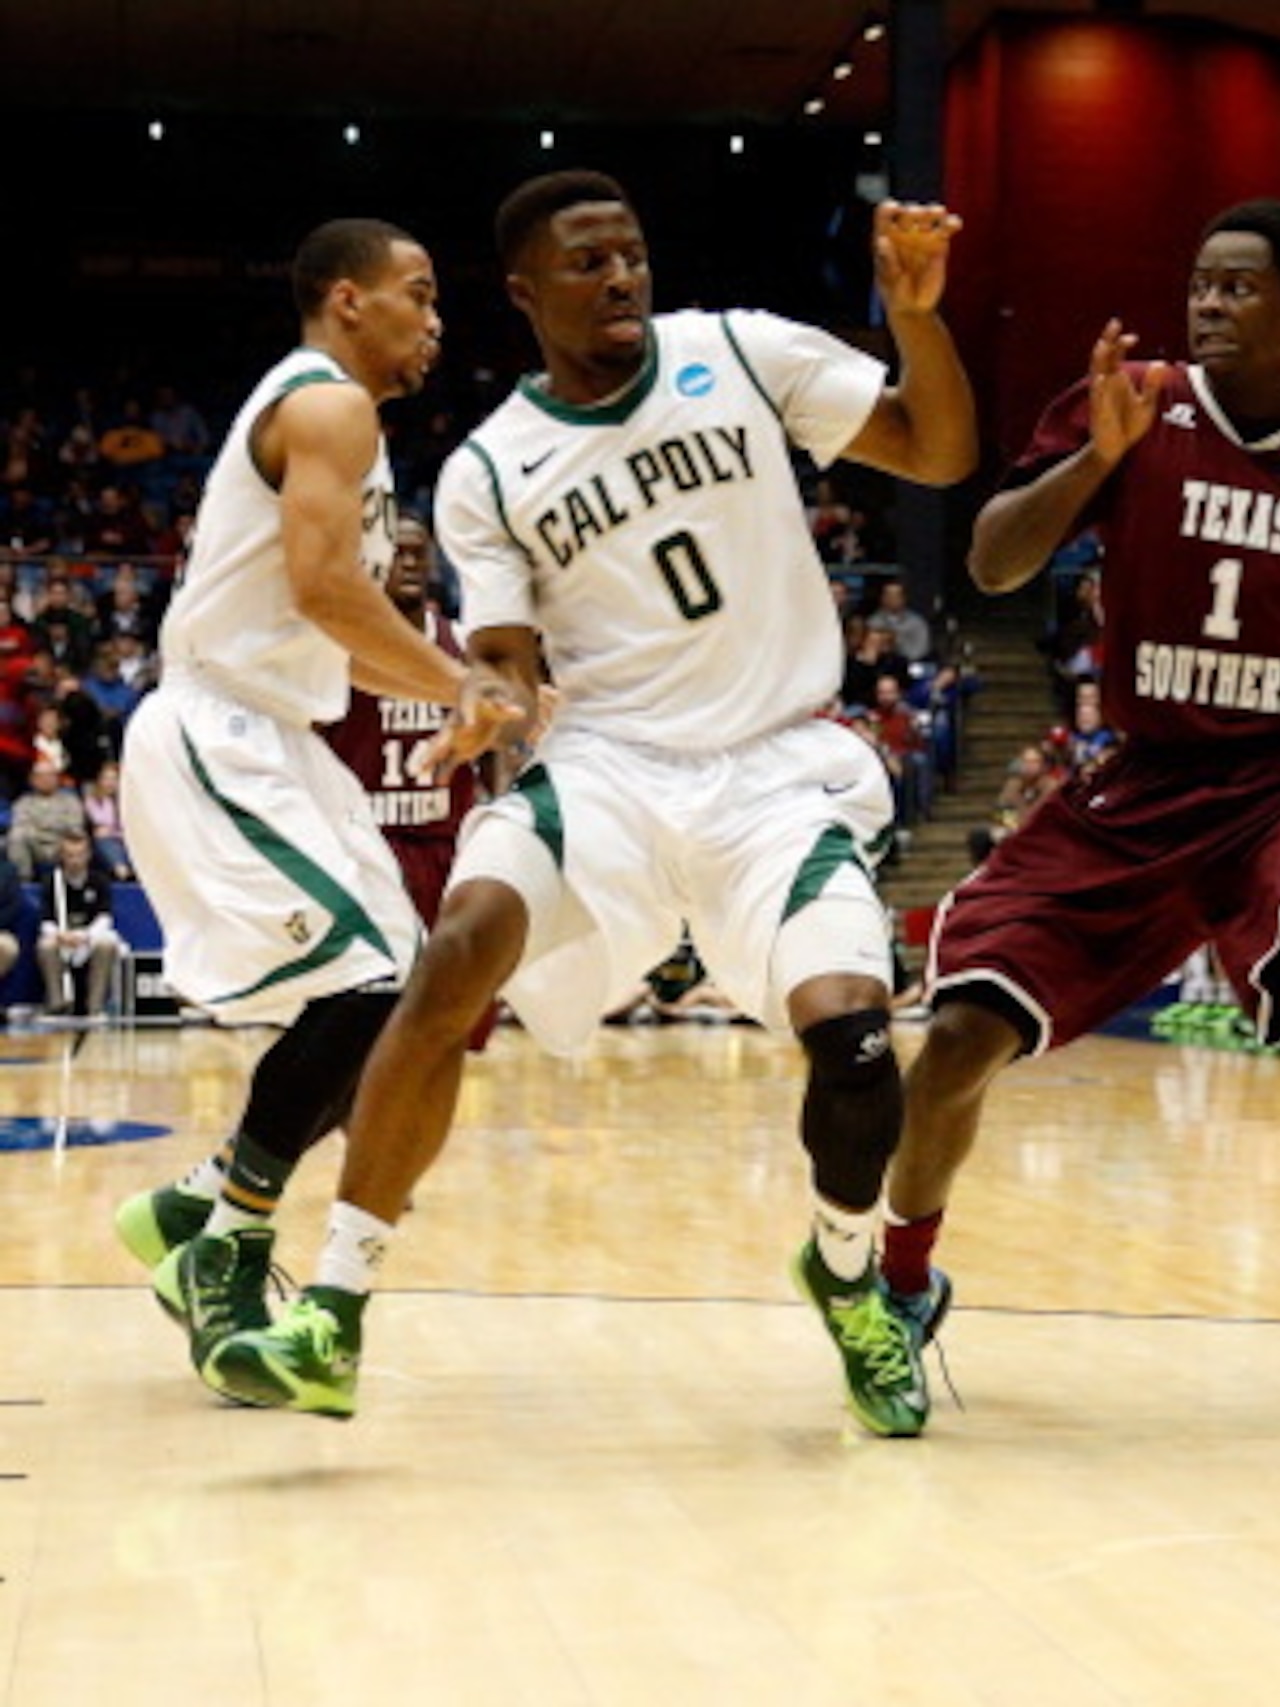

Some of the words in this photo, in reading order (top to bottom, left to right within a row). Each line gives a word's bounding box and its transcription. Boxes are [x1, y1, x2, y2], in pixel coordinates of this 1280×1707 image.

[535, 474, 629, 569] CAL
[625, 426, 755, 509] POLY
[651, 530, 724, 621] 0
[1202, 557, 1244, 641] 1
